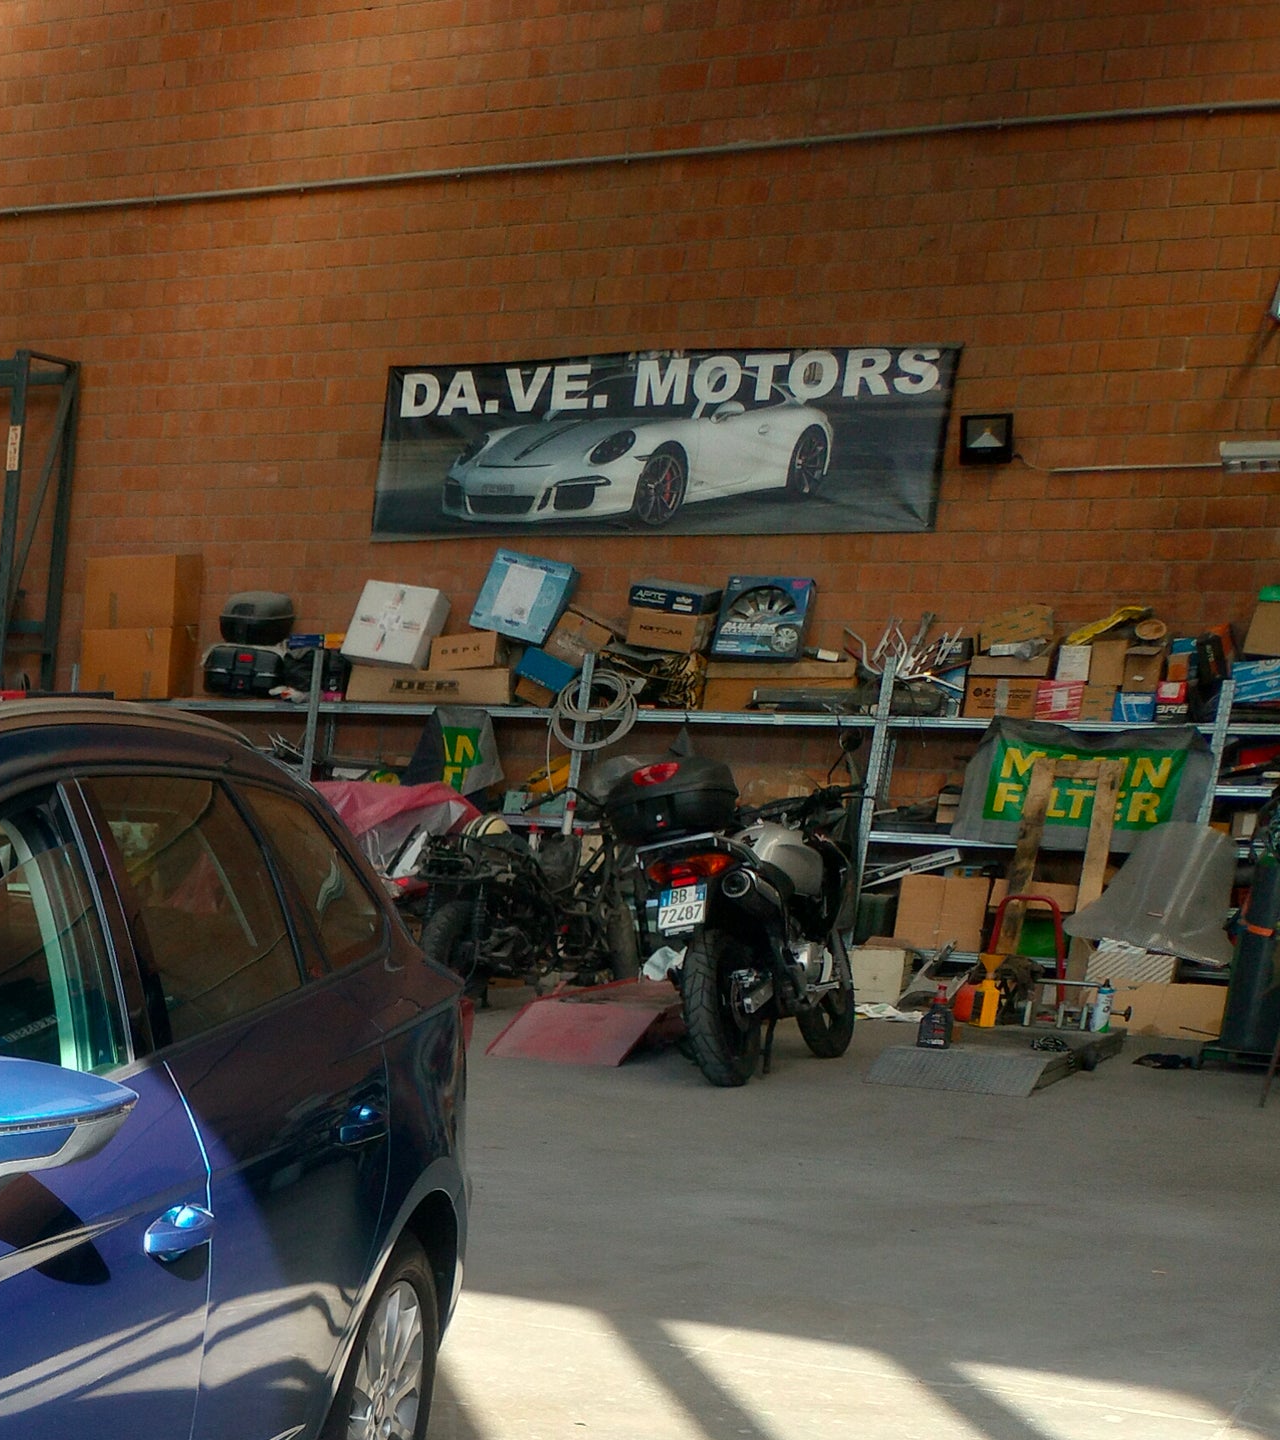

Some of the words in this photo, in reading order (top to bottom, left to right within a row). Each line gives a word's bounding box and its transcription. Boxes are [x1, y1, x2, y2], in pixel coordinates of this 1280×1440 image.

[400, 364, 609, 418] DA.VE.
[634, 347, 940, 408] MOTORS
[671, 888, 687, 904] BB
[660, 903, 702, 925] 72487
